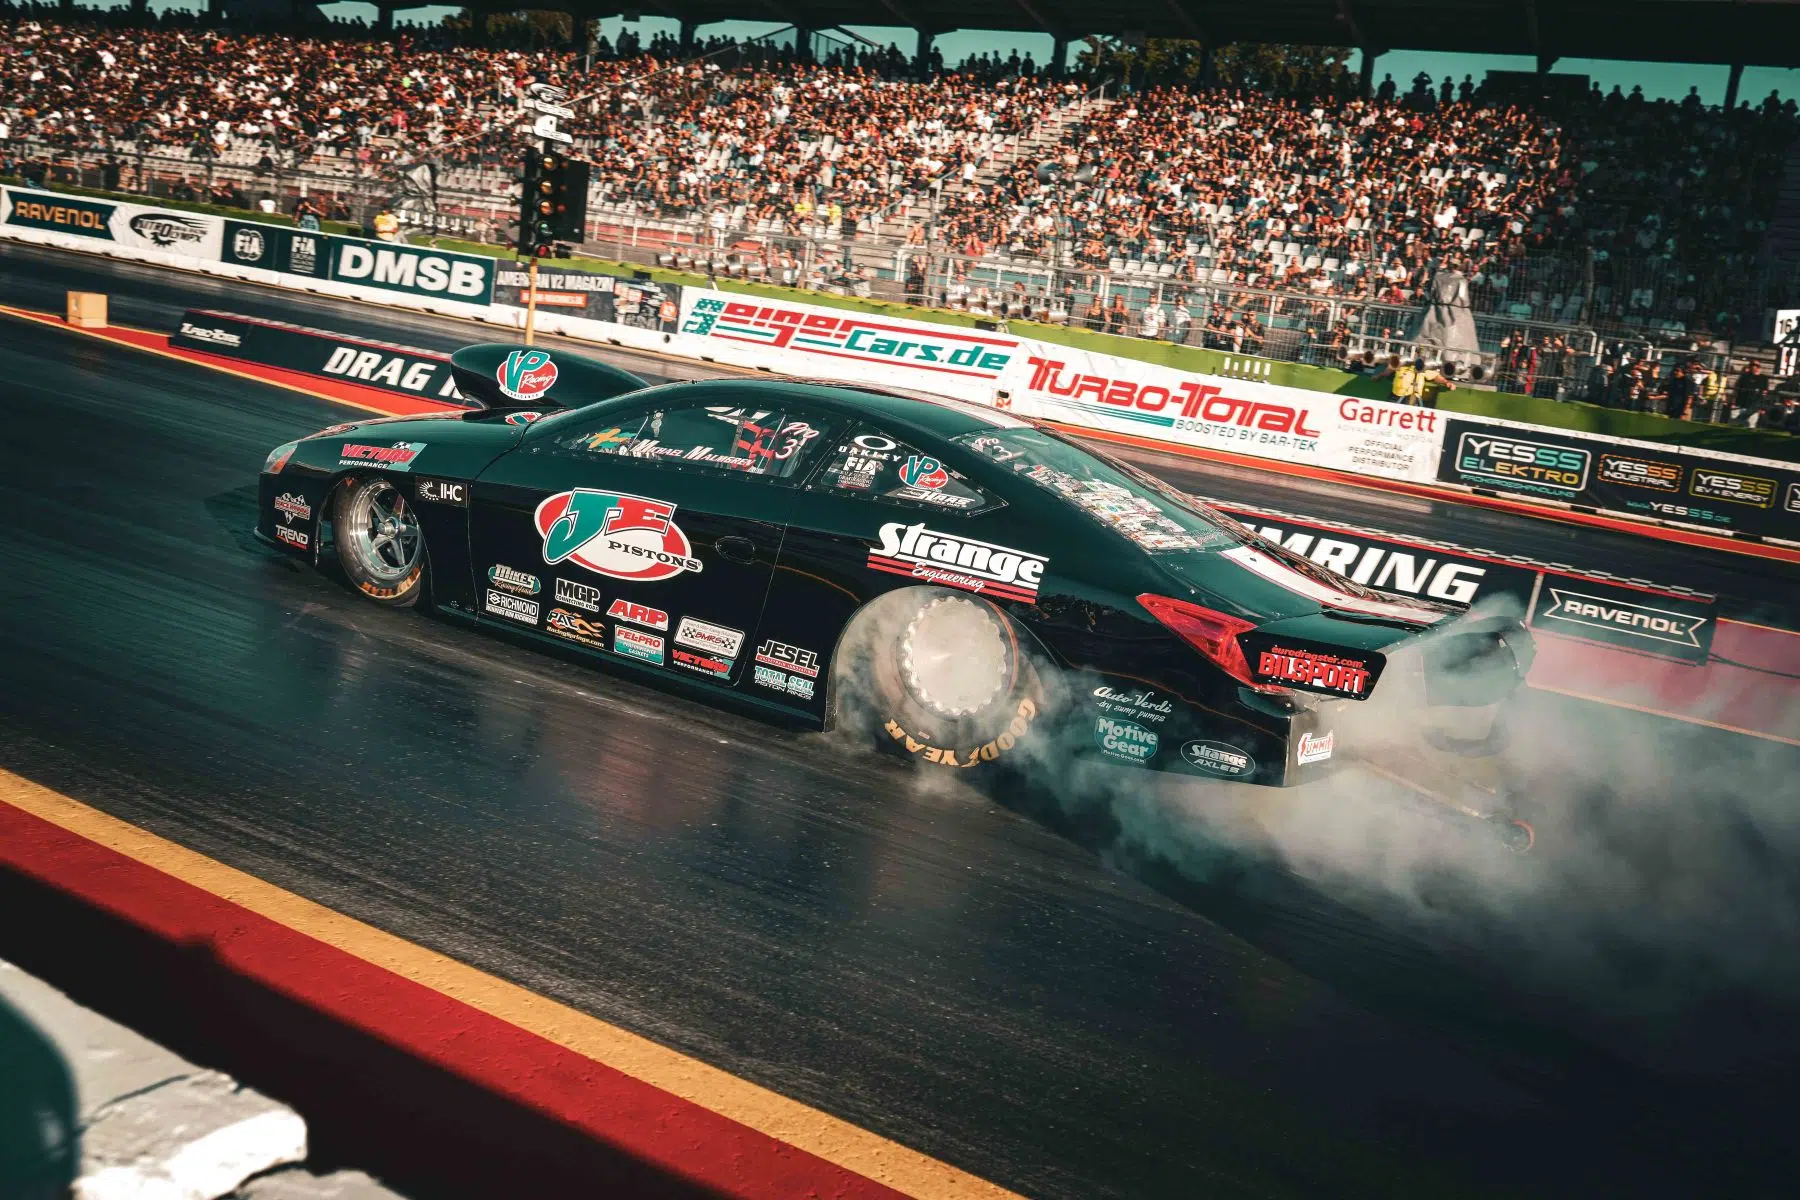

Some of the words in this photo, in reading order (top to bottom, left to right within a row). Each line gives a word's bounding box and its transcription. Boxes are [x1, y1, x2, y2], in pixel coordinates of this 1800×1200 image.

[15, 201, 105, 230] RAVENOL
[291, 236, 316, 256] FIA
[338, 244, 486, 297] DMSB
[322, 346, 438, 391] DRAG
[505, 350, 550, 393] VP
[520, 372, 555, 389] Racing
[1027, 357, 1321, 438] TURBO-TOTAL
[1339, 398, 1437, 433] Garrett
[1176, 420, 1237, 438] BOOSTED
[1239, 430, 1258, 441] BY
[1259, 433, 1319, 452] BAR-TEK
[1364, 439, 1403, 452] OFFICIAL
[341, 444, 417, 464] VICTORY
[630, 439, 683, 457] MICHAEL
[683, 446, 776, 467] MALMGREN
[775, 438, 799, 460] 3
[838, 445, 902, 462] OAKLEY
[1348, 445, 1415, 463] PERFORMANCE
[1467, 437, 1583, 471] YESSS
[339, 459, 390, 470] PERFORMANCE
[843, 456, 877, 475] FIA
[904, 455, 941, 487] VP
[1352, 456, 1410, 470] DISTRIBUTOR
[1462, 456, 1580, 485] ELEKTRO
[1604, 457, 1678, 480] YESSS
[1603, 469, 1676, 489] INDUSTRIAL
[1697, 472, 1772, 495] YESSS
[441, 482, 463, 503] IHC
[1721, 490, 1769, 504] ENERGY
[275, 524, 309, 545] TREND
[541, 487, 678, 566] JE
[607, 539, 700, 572] PISTONS
[869, 522, 1049, 587] Strange
[911, 561, 986, 593] Engineering
[556, 579, 601, 606] MGP
[500, 595, 537, 616] RICHMOND
[609, 600, 669, 628] ARP
[1563, 599, 1686, 636] RAVENOL
[617, 629, 661, 648] FEL-PRO
[694, 632, 723, 645] BMRS
[672, 649, 729, 673] VICTORY
[757, 640, 820, 669] JESEL
[1271, 644, 1364, 669] eurodragster.com
[673, 660, 715, 676] PERFORMANCE
[1258, 651, 1371, 694] BILSPORT
[754, 679, 785, 693] PISTON
[786, 688, 813, 701] RINGS
[755, 665, 787, 688] TOTAL
[787, 675, 815, 697] SEAL
[1093, 686, 1133, 703] Auto
[1134, 691, 1173, 713] Verdi
[1113, 705, 1137, 717] sump
[1136, 710, 1166, 723] pumps
[1098, 718, 1158, 746] Motive
[1103, 734, 1150, 758] Gear
[1190, 744, 1248, 770] Strange
[1193, 758, 1241, 774] AXLES
